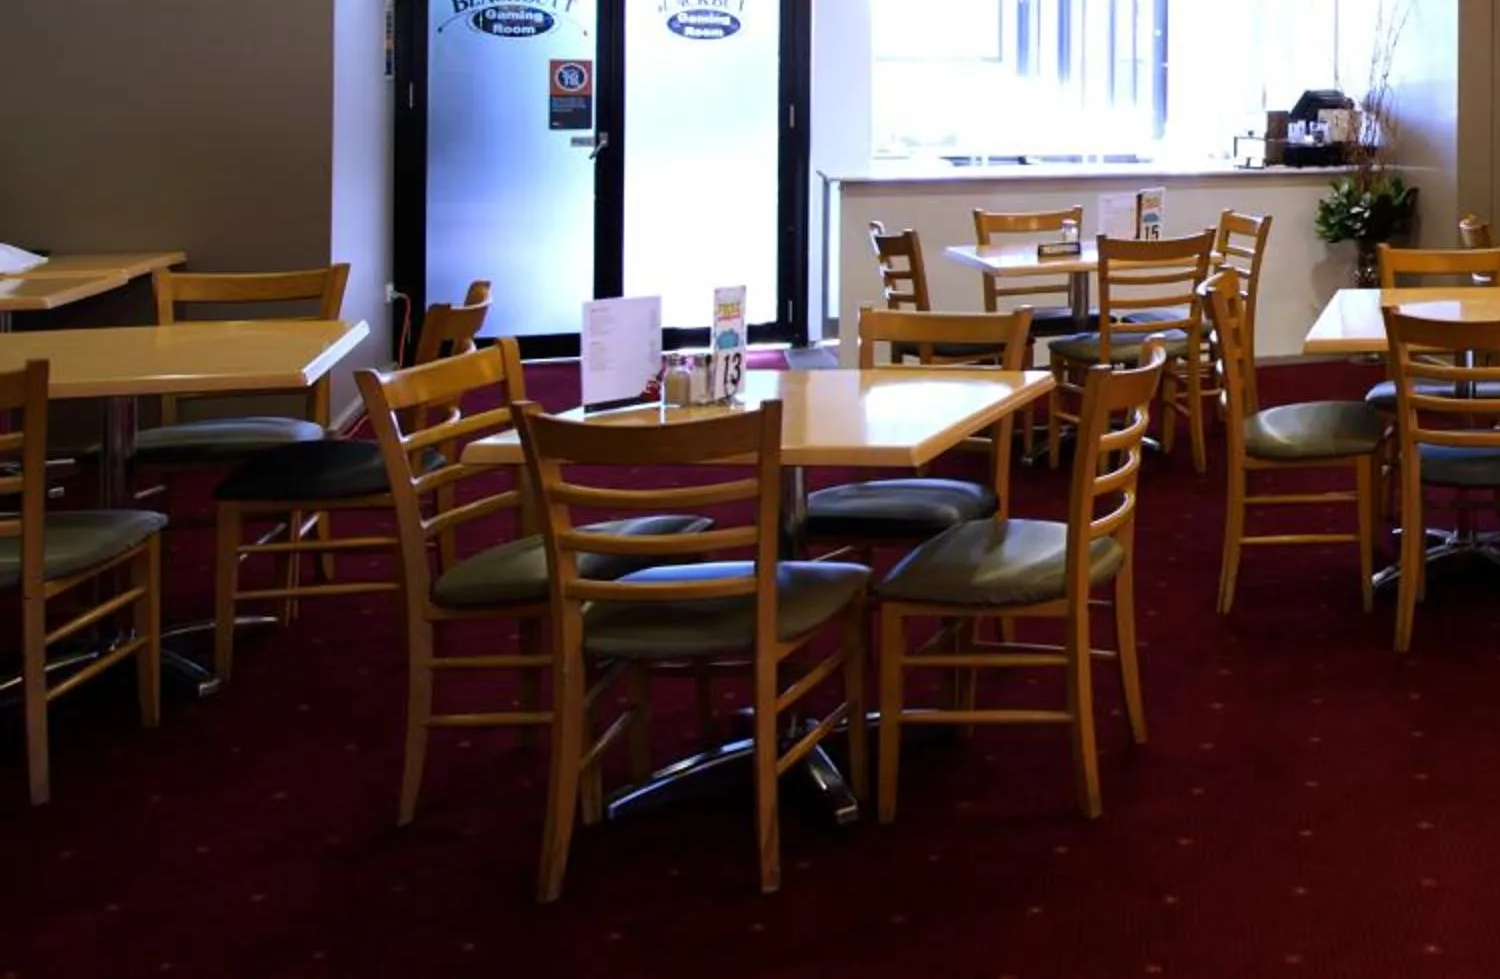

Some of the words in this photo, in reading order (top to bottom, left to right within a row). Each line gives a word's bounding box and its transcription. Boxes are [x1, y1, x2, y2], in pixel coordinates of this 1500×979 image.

[485, 9, 544, 23] Gaming
[677, 12, 731, 26] Gaming
[492, 24, 536, 34] Room
[723, 352, 742, 386] 13
